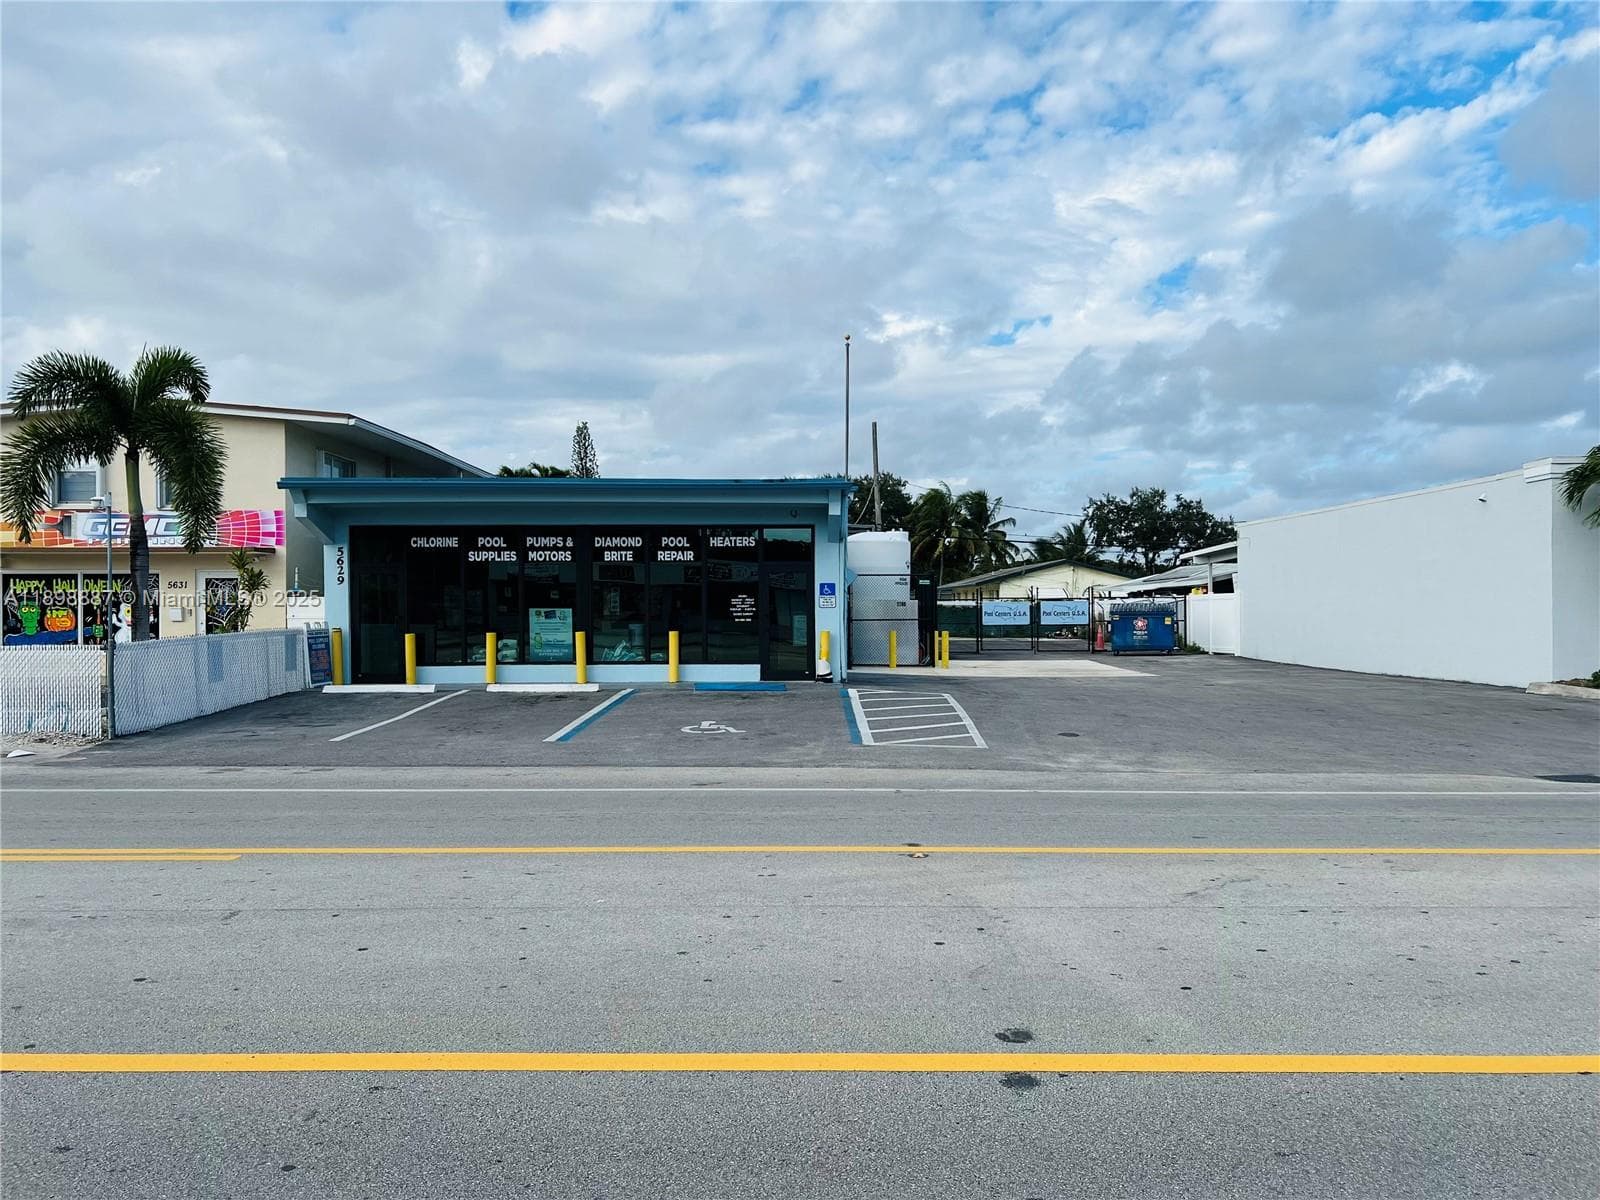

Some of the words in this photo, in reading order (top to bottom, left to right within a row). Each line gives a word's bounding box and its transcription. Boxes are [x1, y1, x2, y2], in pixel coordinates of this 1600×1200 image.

[410, 536, 459, 548] CHLORINE
[477, 536, 507, 548] POOL
[526, 536, 564, 548] PUMPS
[565, 536, 574, 548] &
[594, 536, 643, 548] DIAMOND
[661, 536, 690, 548] POOL
[709, 536, 756, 547] HEATERS
[468, 550, 517, 562] SUPPLIES
[528, 550, 572, 562] MOTORS
[604, 550, 634, 561] BRITE
[657, 550, 694, 561] REPAIR
[336, 546, 345, 586] 5629
[10, 578, 45, 593] HAPPY
[53, 578, 121, 592] HALLOWEN
[167, 580, 188, 589] 5631
